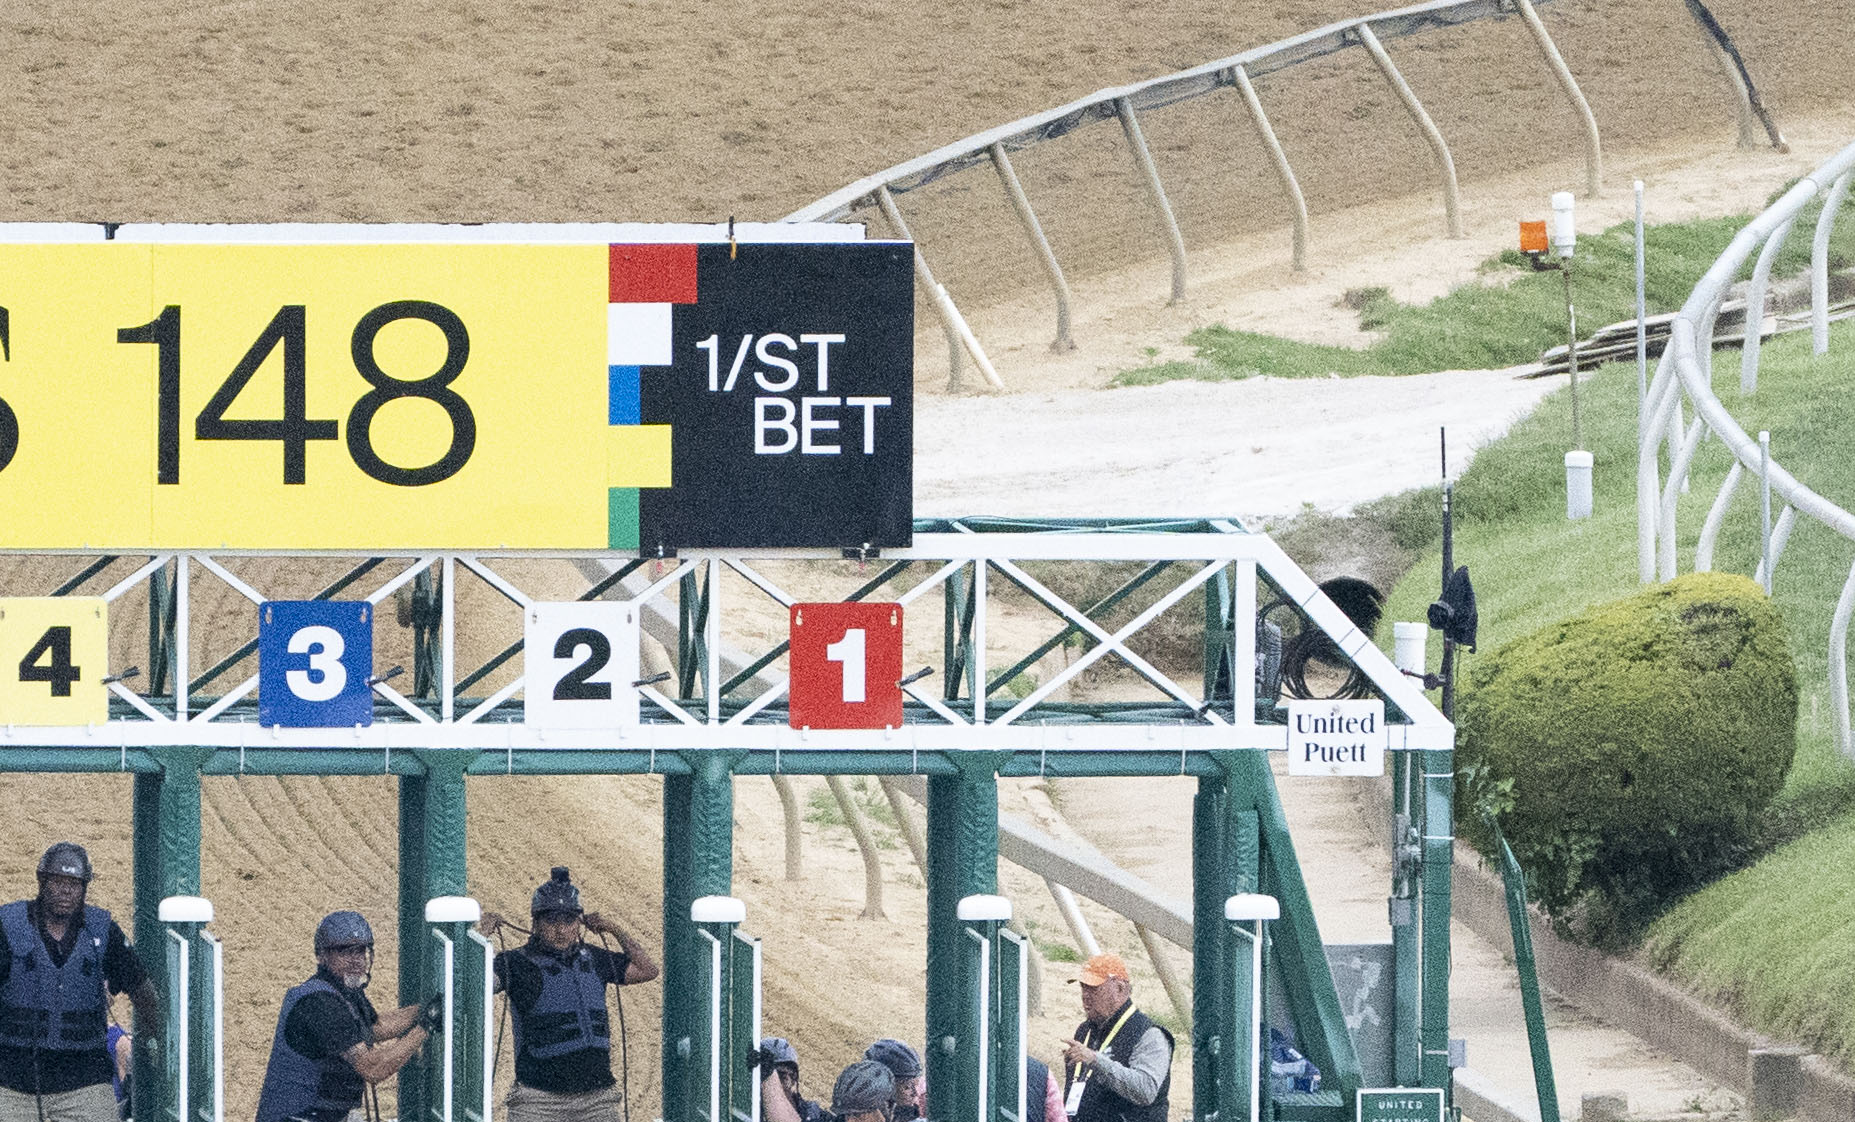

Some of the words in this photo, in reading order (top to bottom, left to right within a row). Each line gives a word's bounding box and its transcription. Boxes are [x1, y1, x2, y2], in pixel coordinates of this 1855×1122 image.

[116, 299, 478, 488] 148
[695, 332, 846, 393] 1/ST
[754, 396, 892, 455] BET
[18, 625, 82, 698] 4
[284, 625, 348, 703] 3
[552, 628, 613, 702] 2
[825, 628, 866, 703] 1
[1296, 711, 1375, 734] United
[1304, 742, 1367, 762] Puett
[1378, 1100, 1423, 1110] UNITED
